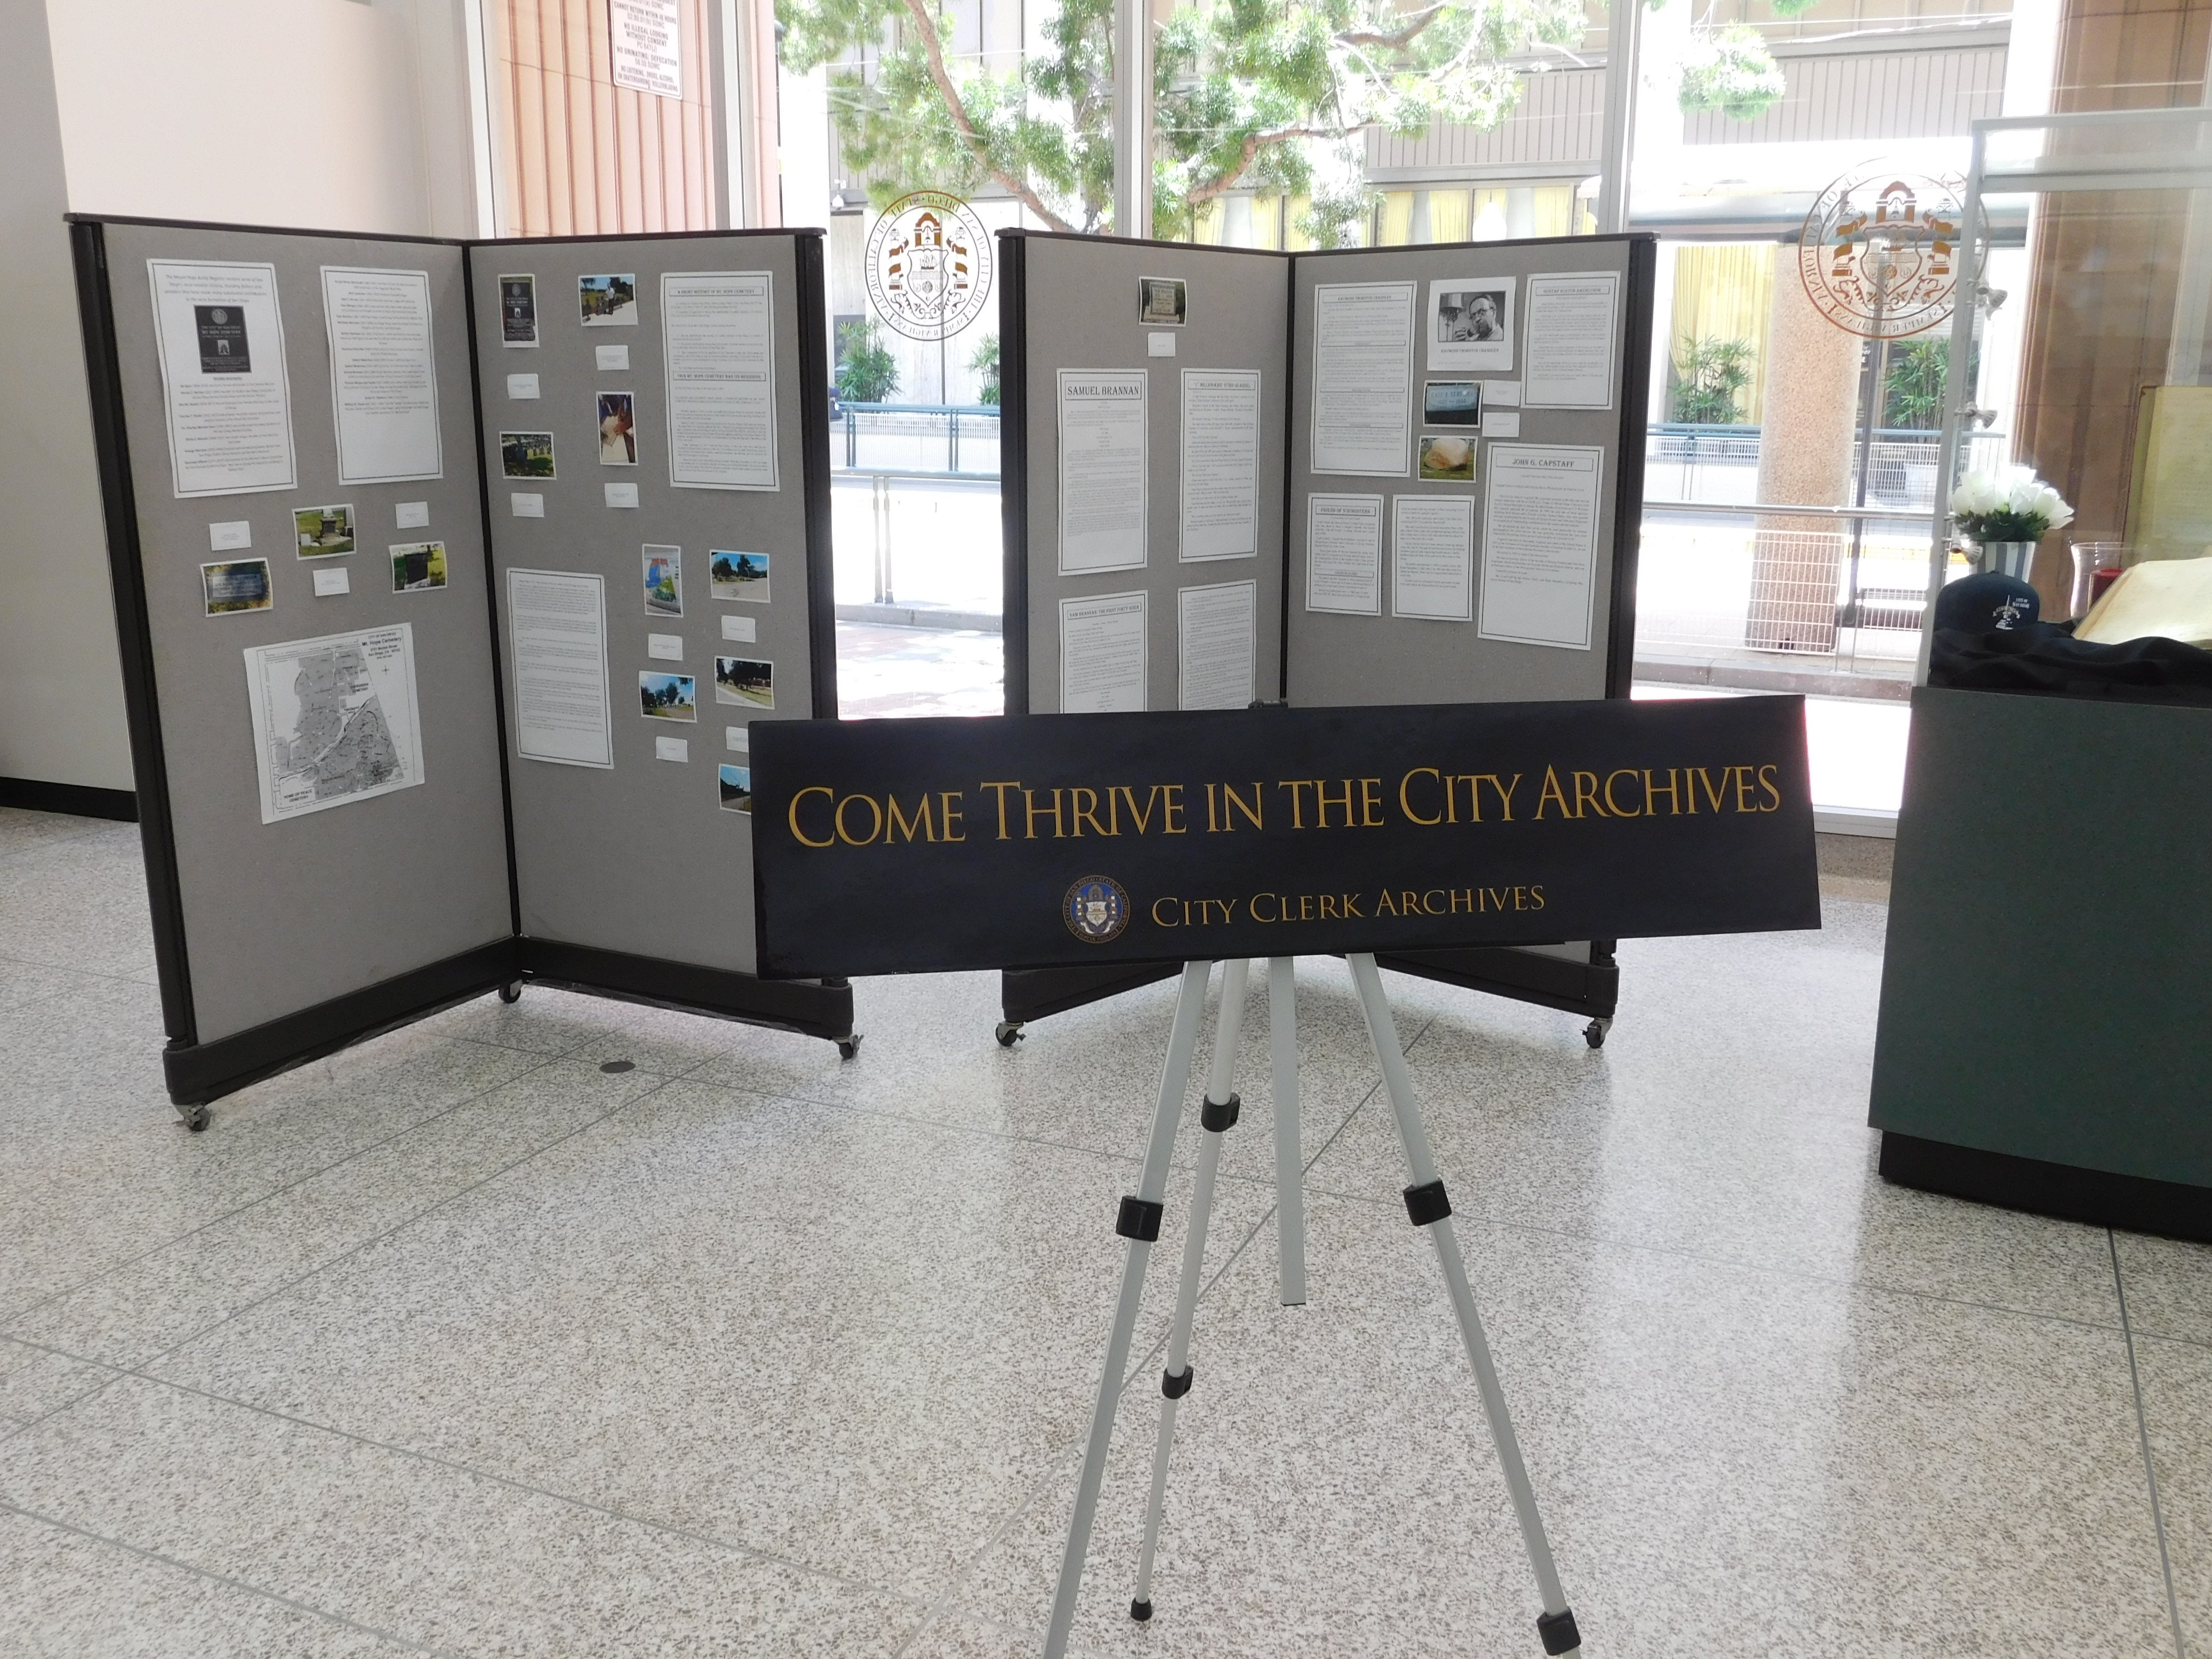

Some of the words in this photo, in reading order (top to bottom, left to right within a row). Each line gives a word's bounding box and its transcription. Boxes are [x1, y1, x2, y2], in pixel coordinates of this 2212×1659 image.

[630, 5, 644, 15] RETURN
[645, 10, 658, 19] WITHIN
[626, 30, 646, 42] WITHOUT
[647, 36, 667, 47] CONSENT
[631, 24, 649, 35] ILLEGAL
[649, 29, 668, 40] LODGING
[637, 41, 643, 49] PC
[617, 46, 623, 54] NO
[651, 54, 677, 66] DEFECATION
[1068, 386, 1100, 395] SAMUEL
[1102, 386, 1139, 395] BRANNAN
[789, 786, 966, 847] COME
[980, 781, 1187, 841] THRIVE
[1203, 781, 1264, 833] IN
[1278, 778, 1385, 829] THE
[1399, 767, 1524, 826] CITY
[1531, 763, 1781, 820] ARCHIVES
[1152, 897, 1238, 927] CITY
[1250, 892, 1367, 923] CLERK
[1374, 885, 1546, 917] ARCHIVES
